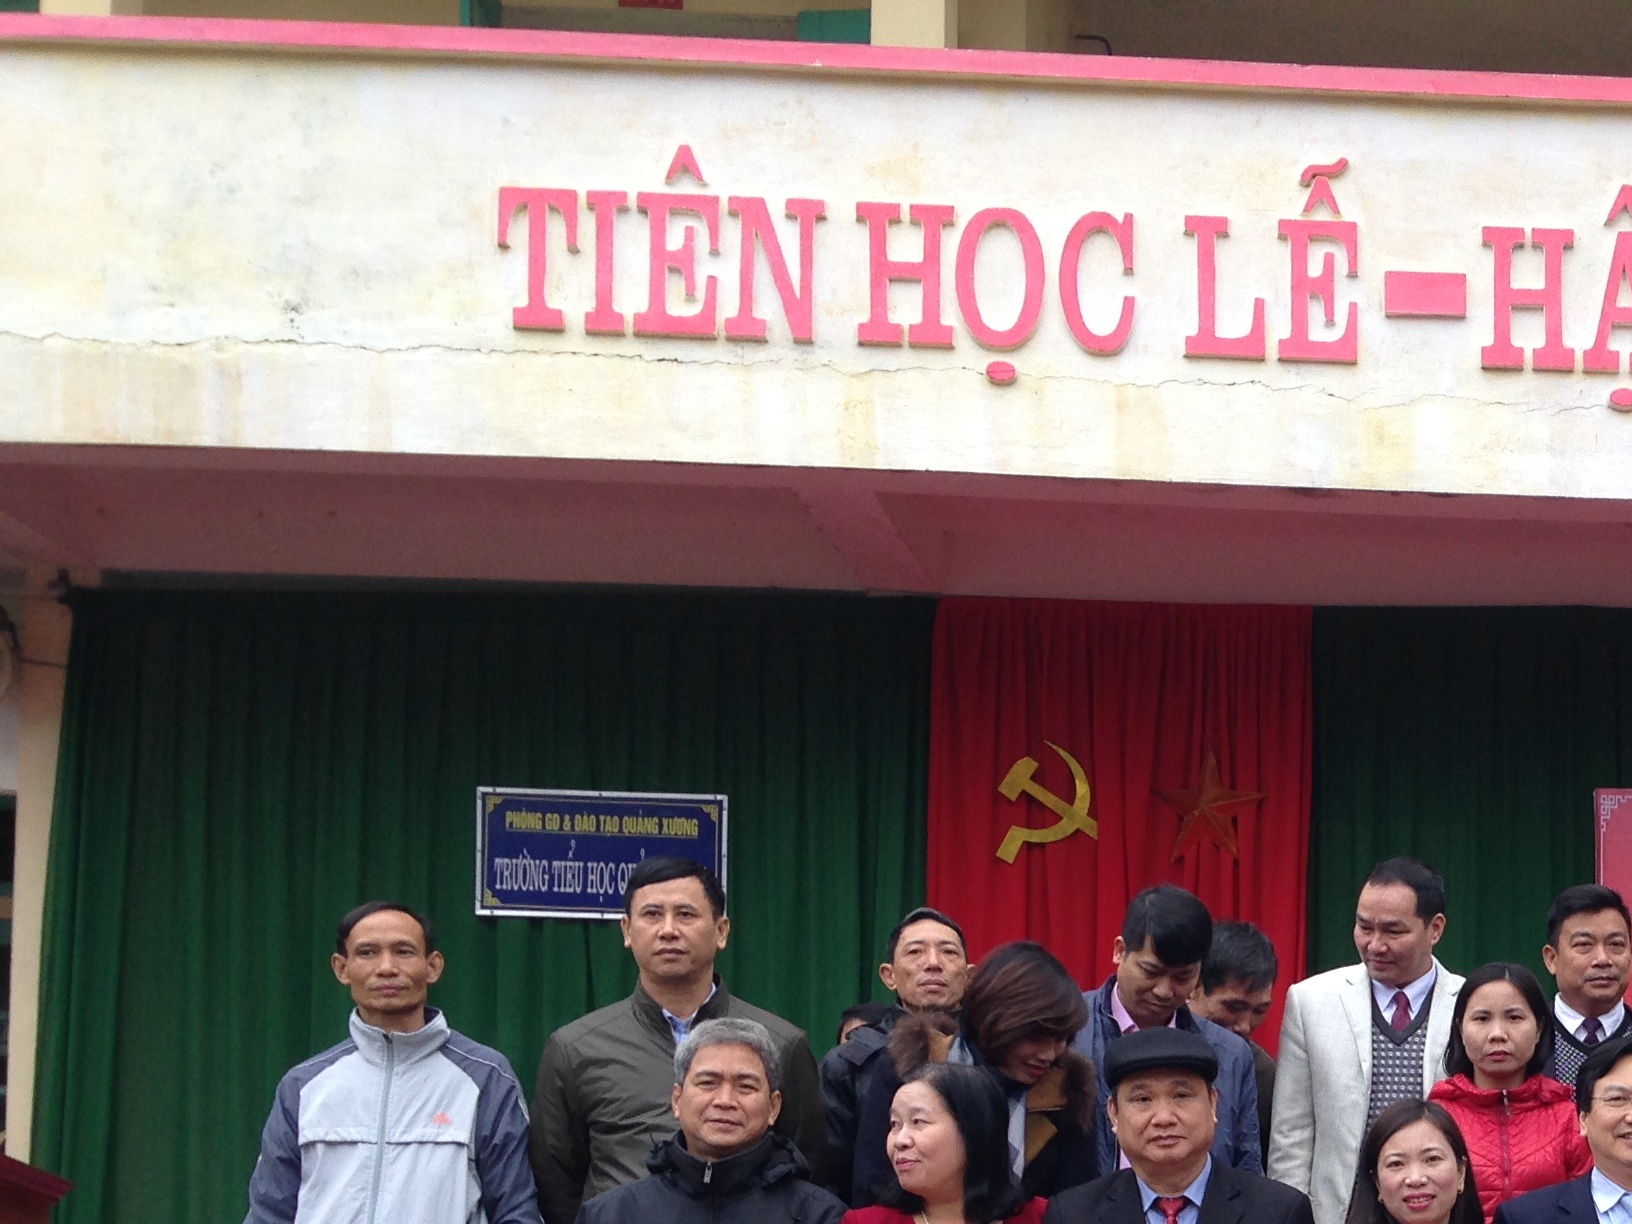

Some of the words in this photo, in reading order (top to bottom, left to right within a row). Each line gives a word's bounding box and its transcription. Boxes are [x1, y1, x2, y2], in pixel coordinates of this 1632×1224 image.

[856, 201, 1137, 385] HỌC
[1182, 156, 1360, 363] LỄ
[545, 812, 560, 831] GD
[563, 814, 571, 831] &
[599, 815, 619, 836] TẠO
[494, 847, 550, 892] TRƯỜNG
[552, 838, 584, 894] TIỂU
[586, 860, 616, 903] HỌC
